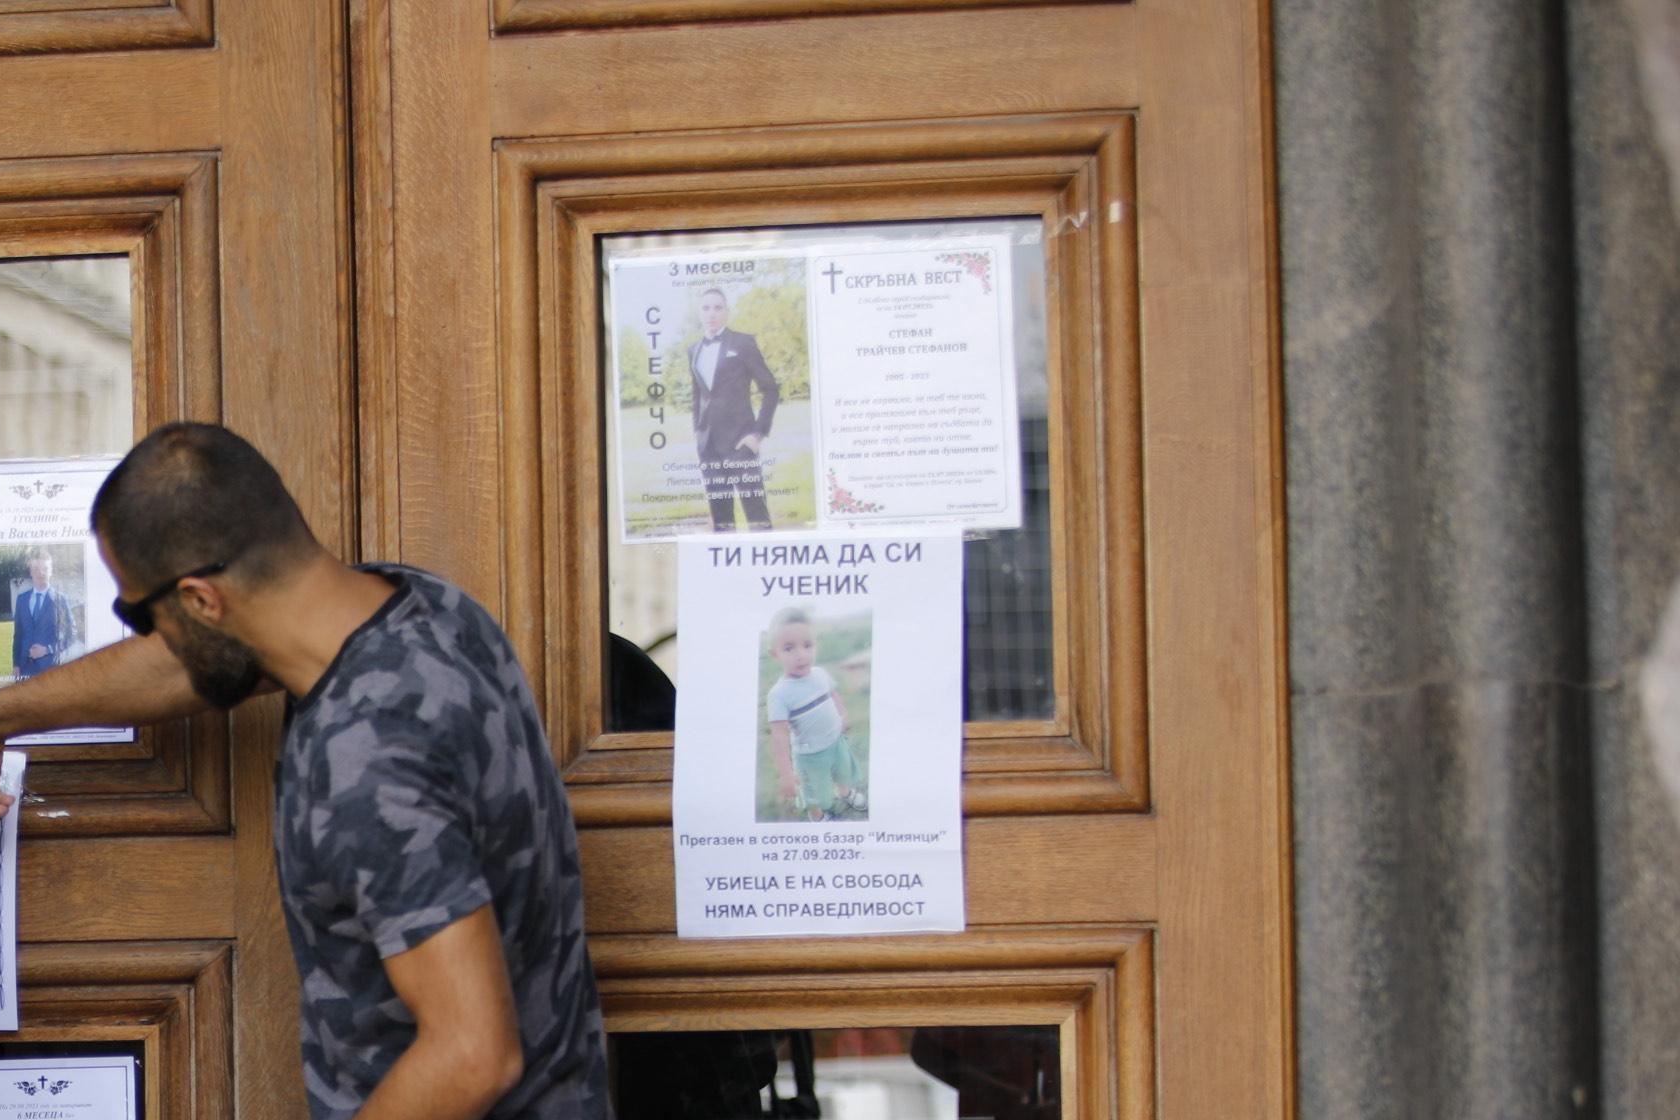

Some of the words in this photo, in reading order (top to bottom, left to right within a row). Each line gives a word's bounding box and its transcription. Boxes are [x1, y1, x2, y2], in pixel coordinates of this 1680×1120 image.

[668, 262, 680, 277] 3
[685, 260, 756, 276] месеца
[844, 274, 918, 290] СКРЪБНА
[924, 270, 963, 286] ВЕСТ
[888, 328, 934, 340] СТЕФАН
[856, 345, 906, 358] ТРАЙЧЕВ
[908, 342, 968, 355] СТЕФАНОВ
[710, 460, 721, 470] те
[726, 476, 740, 486] до
[8, 527, 58, 540] Василев
[61, 526, 92, 538] Нико
[708, 547, 742, 568] ТИ
[752, 545, 830, 567] НЯМА
[838, 543, 877, 568] ДА
[885, 541, 922, 564] СИ
[761, 574, 869, 598] УЧЕНИК
[679, 833, 744, 849] Прегазен
[749, 836, 757, 845] в
[761, 834, 820, 846] сотоков
[823, 831, 864, 849] базар
[762, 852, 779, 862] на
[782, 848, 865, 863] 27.09.2023г.
[705, 876, 779, 894] УБИЕЦА
[785, 876, 796, 890] Е
[801, 875, 826, 889] НА
[831, 873, 923, 892] СВОБОДА
[705, 904, 757, 919] НЯМА
[763, 901, 926, 919] СПРАВЕДЛИВОСТ
[23, 1110, 63, 1120] МЕСЕЦА
